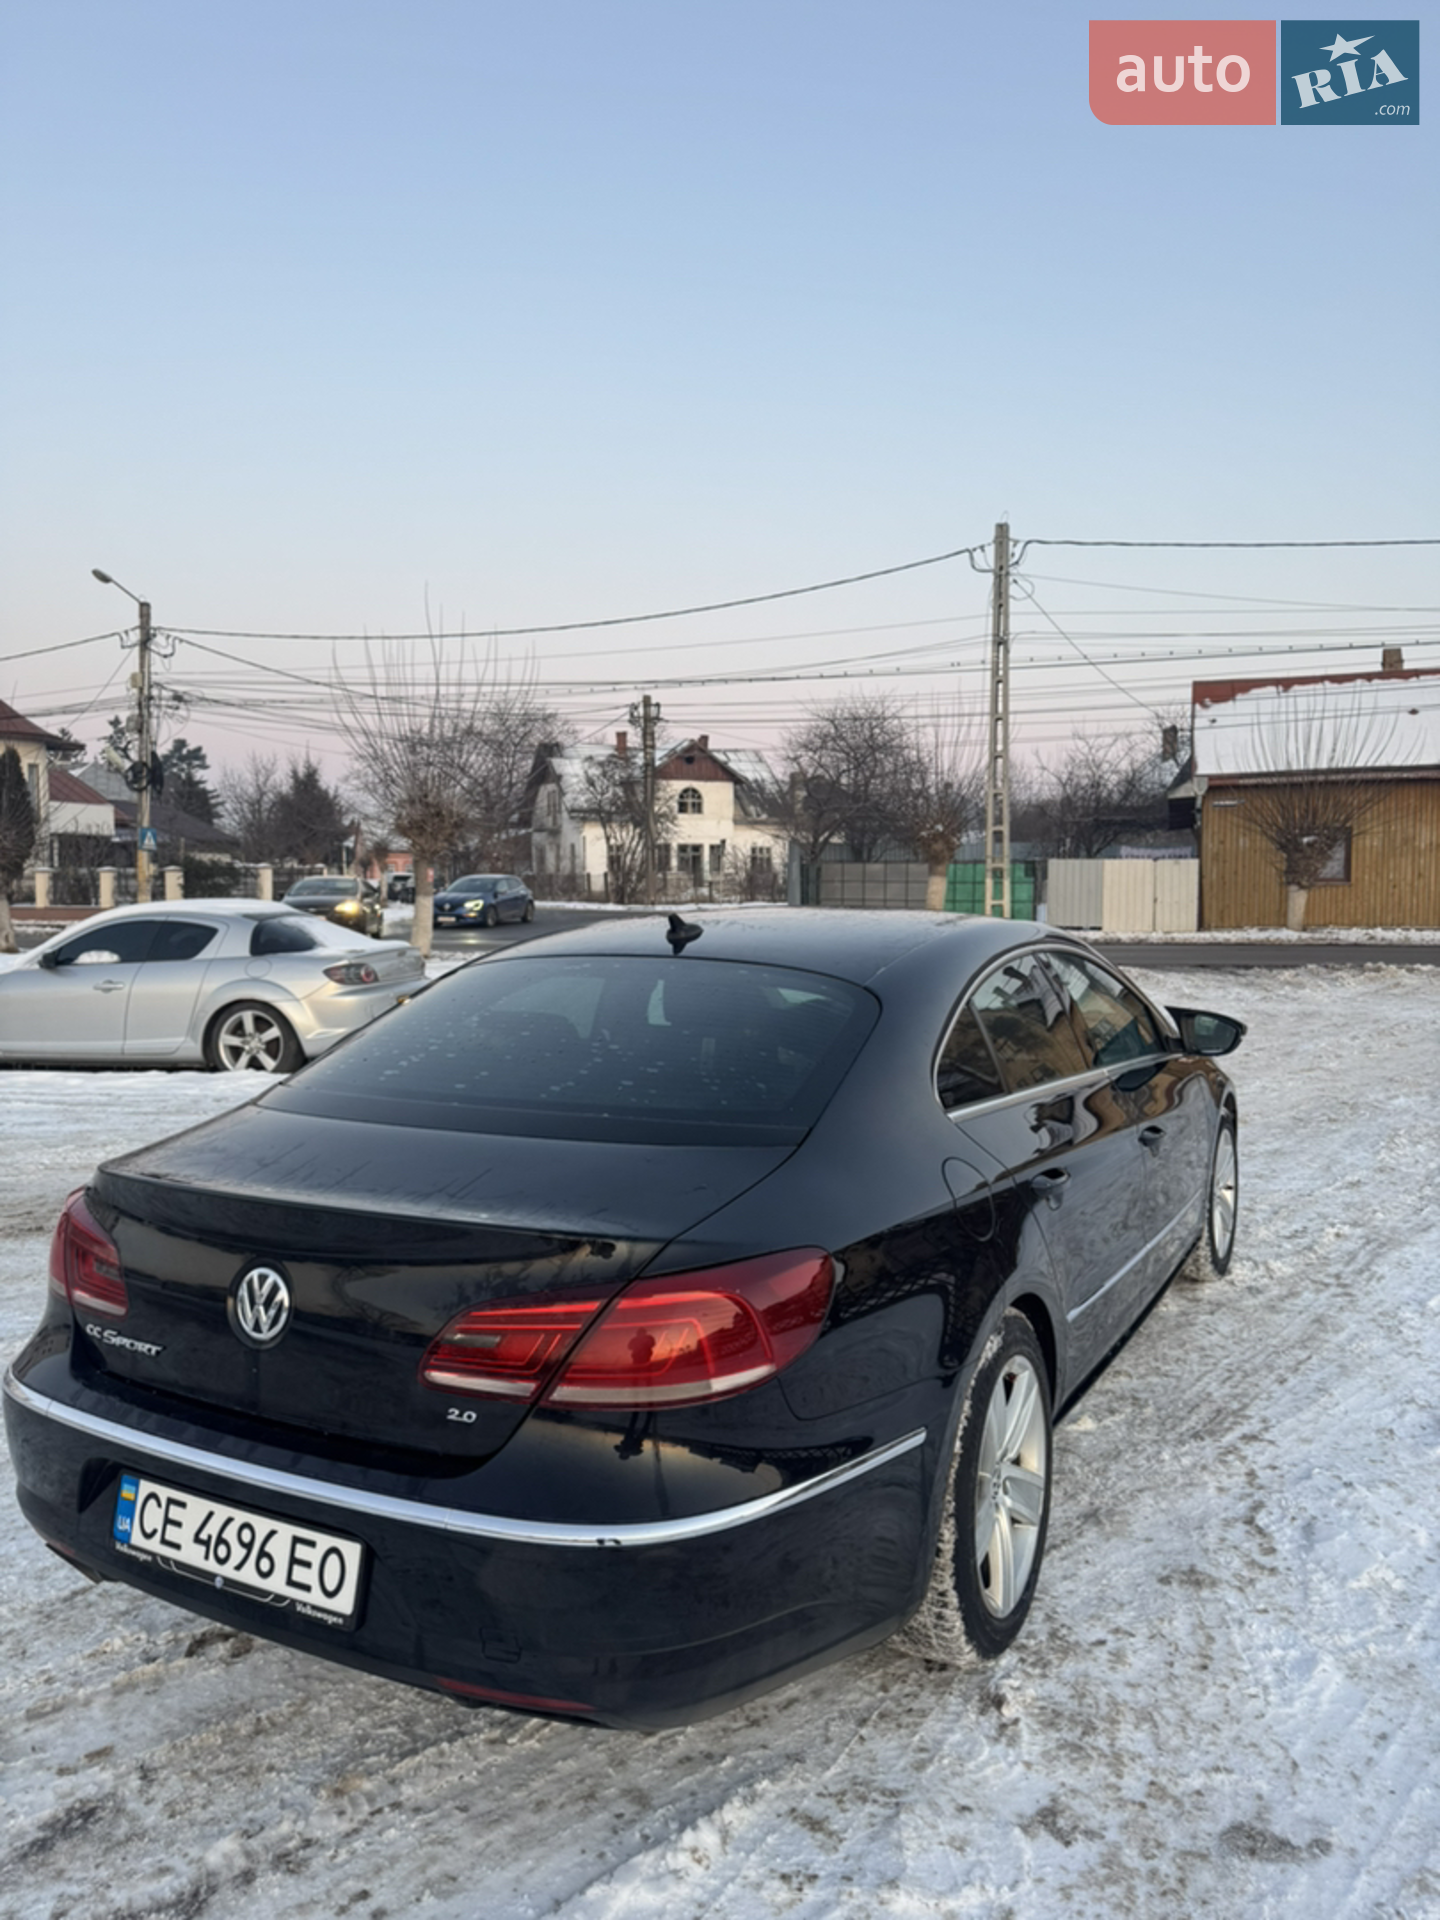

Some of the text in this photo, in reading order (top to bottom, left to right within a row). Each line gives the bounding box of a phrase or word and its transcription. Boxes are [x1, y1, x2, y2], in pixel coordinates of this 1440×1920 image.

[446, 1407, 477, 1423] 2.0
[117, 1515, 131, 1532] UA
[138, 1491, 346, 1599] CE 4696 EO
